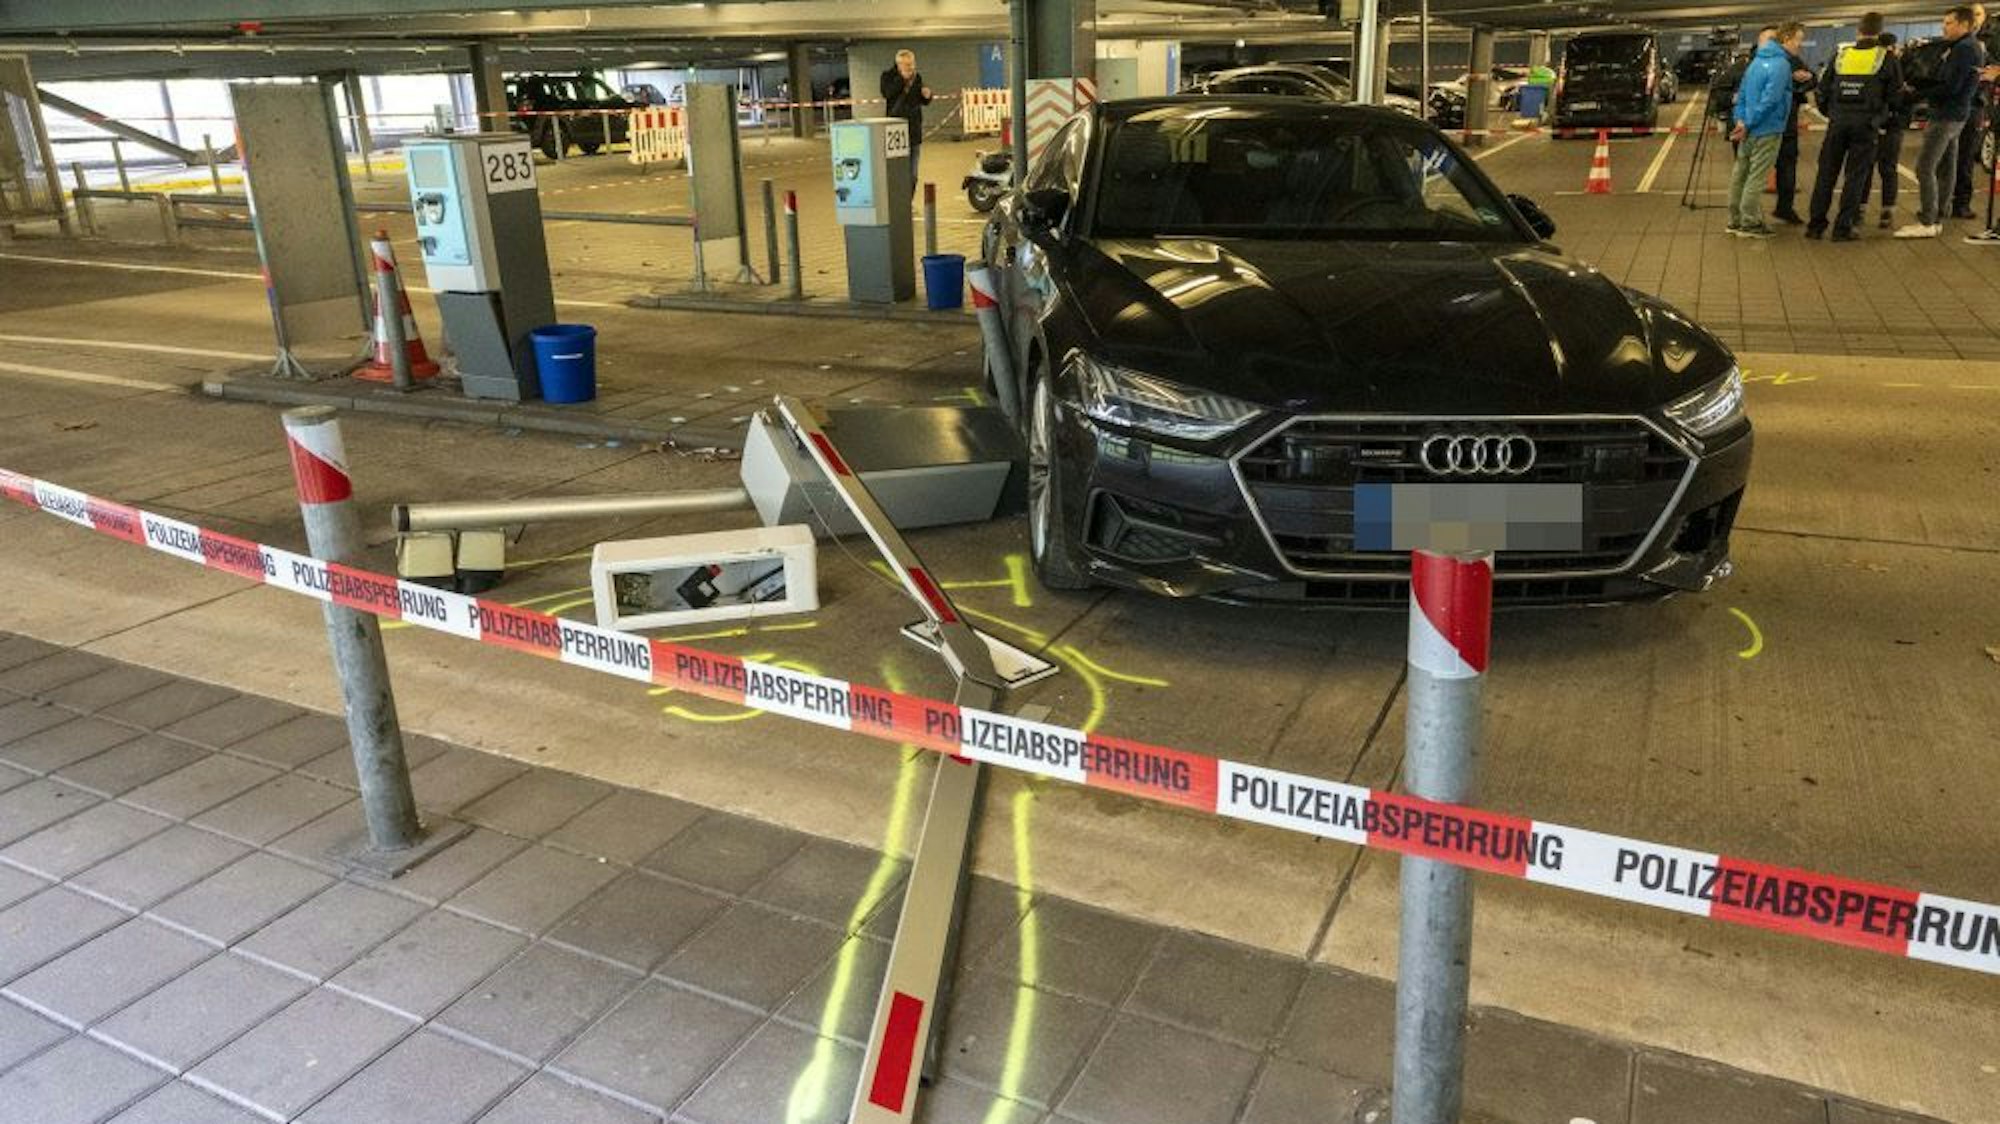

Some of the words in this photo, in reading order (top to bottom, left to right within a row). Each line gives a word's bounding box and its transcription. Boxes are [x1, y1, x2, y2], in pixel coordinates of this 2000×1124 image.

[991, 45, 1003, 61] A
[887, 130, 907, 150] 281
[487, 152, 531, 183] 283
[146, 519, 277, 577] POLIZEIABSPERRUNG
[292, 561, 448, 622] POLIZEIABSPERRUNG
[468, 604, 650, 671] POLIZEIABSPERRUNG
[674, 653, 893, 728] POLIZEIABSPERRUNG
[925, 708, 1191, 791] POLIZEIABSPERRUNG
[1231, 772, 1565, 870] POLIZEIABSPERRUNG
